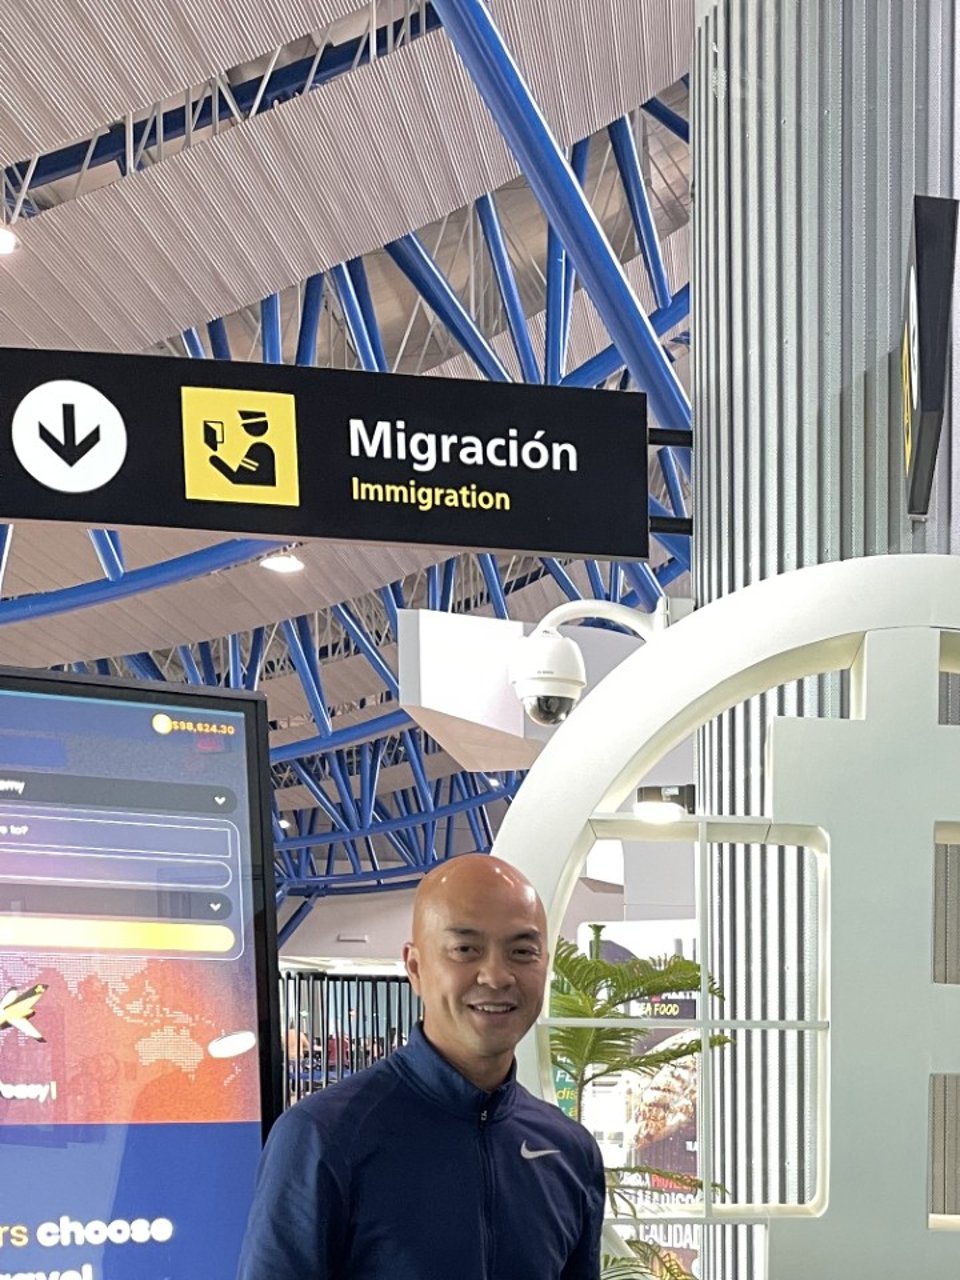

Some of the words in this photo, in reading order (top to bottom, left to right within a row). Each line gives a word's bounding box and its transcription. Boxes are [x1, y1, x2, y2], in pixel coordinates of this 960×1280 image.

[349, 418, 578, 472] Migración
[352, 476, 511, 511] Immigration
[654, 1003, 679, 1016] FOOD
[36, 1215, 173, 1247] choose
